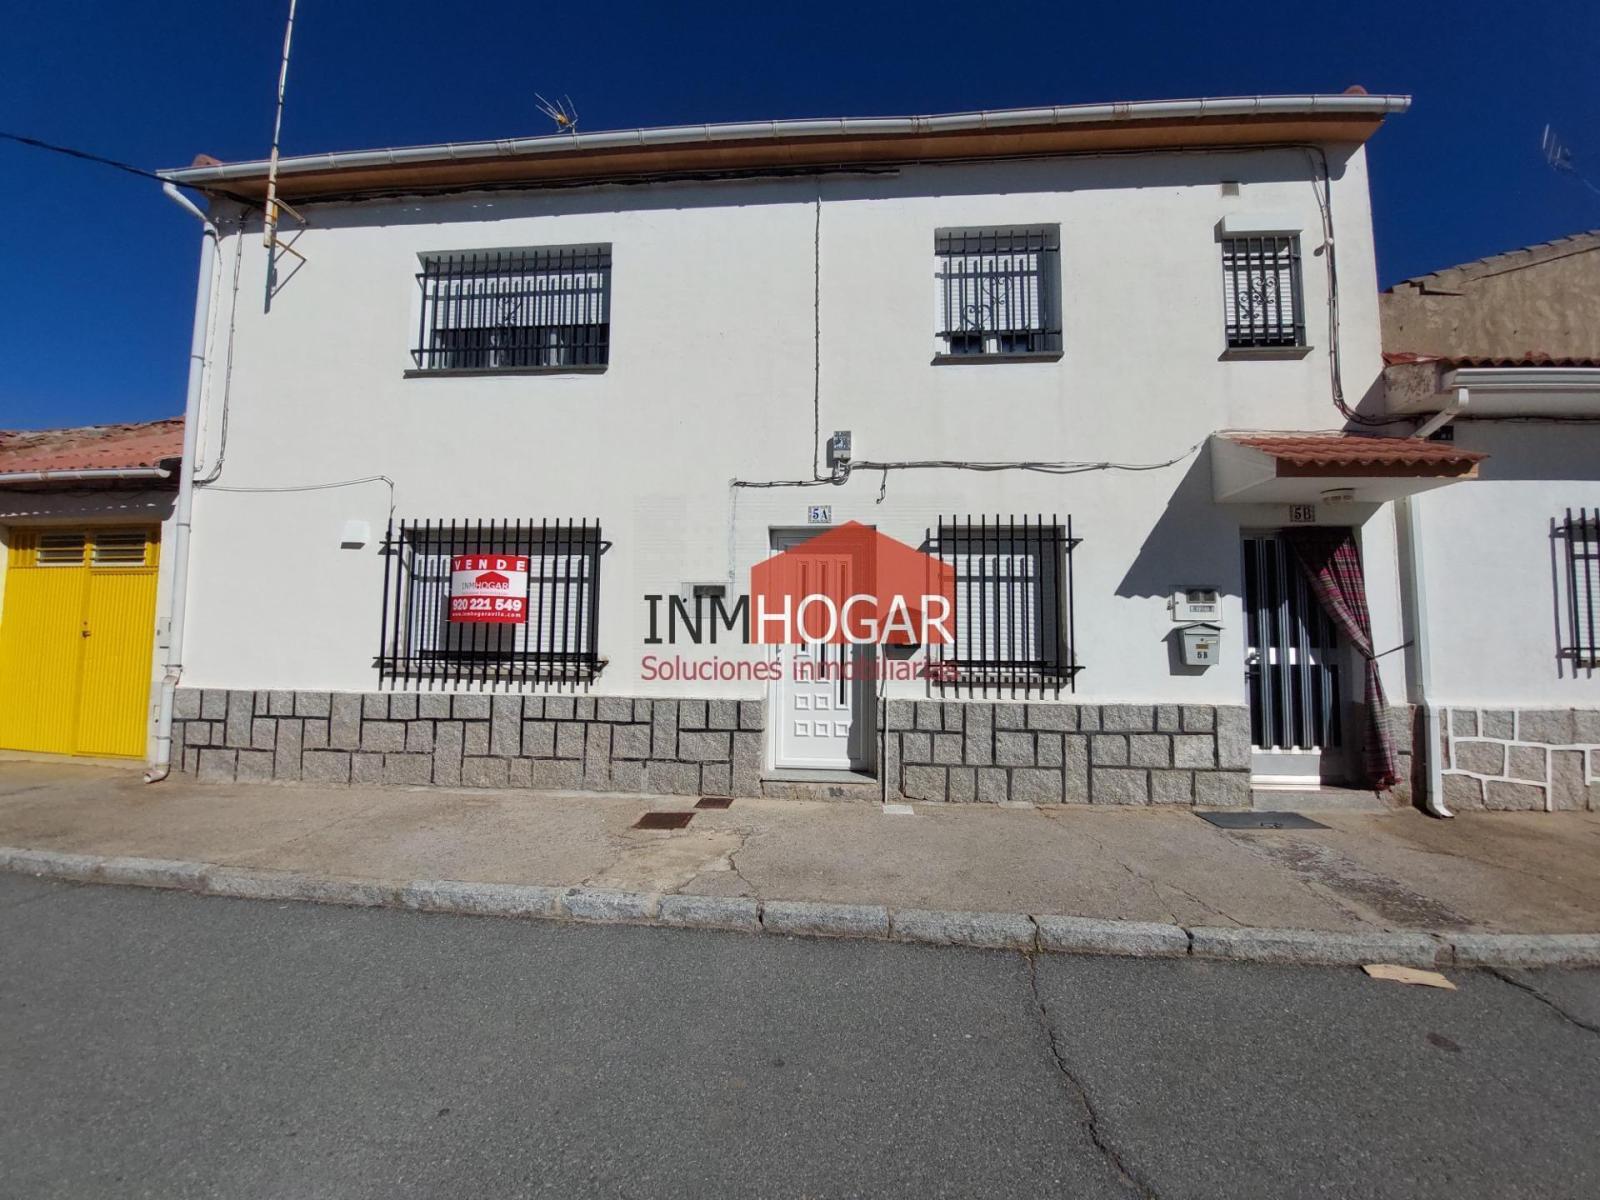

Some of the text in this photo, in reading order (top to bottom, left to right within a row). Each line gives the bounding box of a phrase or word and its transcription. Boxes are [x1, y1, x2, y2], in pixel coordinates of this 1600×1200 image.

[1294, 507, 1312, 520] 5B
[454, 559, 526, 571] VENDE
[453, 598, 522, 612] 920 221 549
